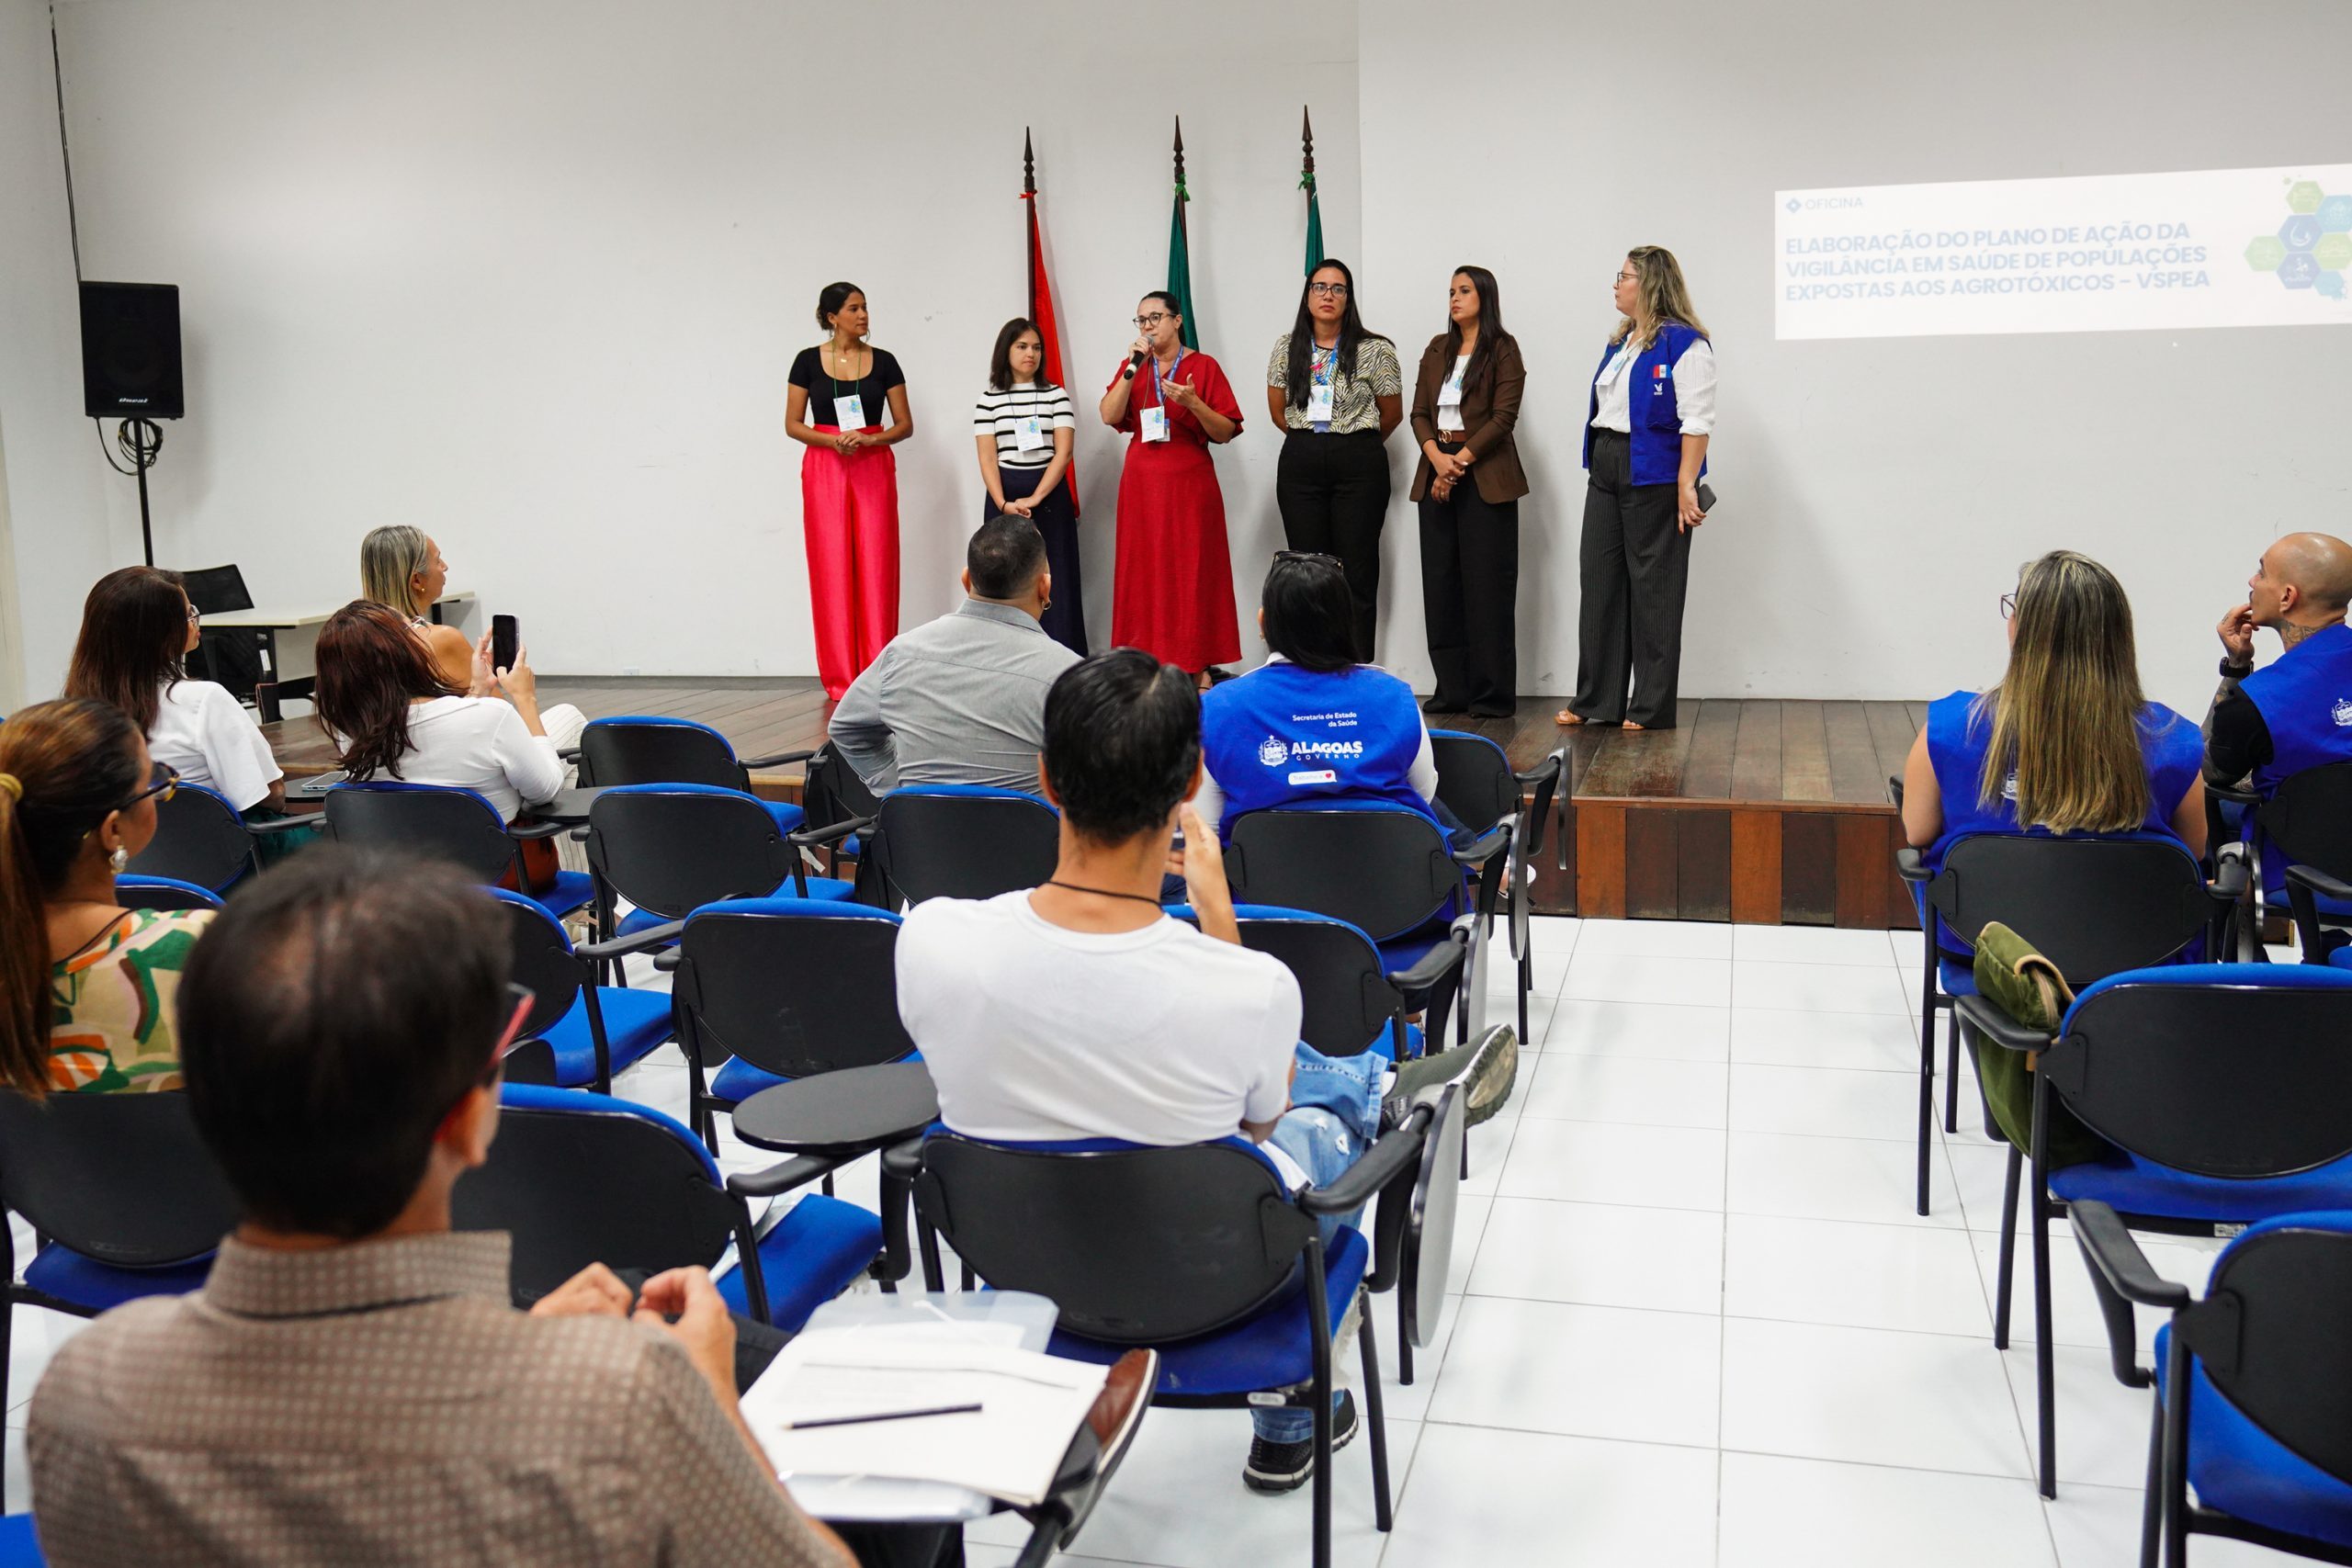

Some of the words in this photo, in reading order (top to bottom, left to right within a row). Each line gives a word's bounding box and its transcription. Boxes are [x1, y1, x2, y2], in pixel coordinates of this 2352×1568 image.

[1804, 197, 1864, 209] OFICINA
[1785, 229, 1933, 256] ELABORAÇÃO
[1936, 231, 1970, 250] DO
[1973, 228, 2048, 248] PLANO
[2051, 226, 2080, 244] DE
[2083, 220, 2154, 248] AÇÃO
[2156, 222, 2191, 241] DA
[1785, 254, 1908, 278] VIGILÂNCIA
[1912, 255, 1944, 274] EM
[1948, 249, 2020, 272] SAÚDE
[2024, 251, 2052, 269] DE
[2055, 243, 2208, 271] POPULAÇÕES
[1785, 282, 1896, 301] EXPOSTAS
[1899, 279, 1947, 297] AOS
[1950, 272, 2116, 295] AGROTÓXICOS
[2135, 269, 2211, 289] VSPEA
[1291, 740, 1363, 755] ALAGOAS
[1295, 753, 1361, 761] GOVERNO
